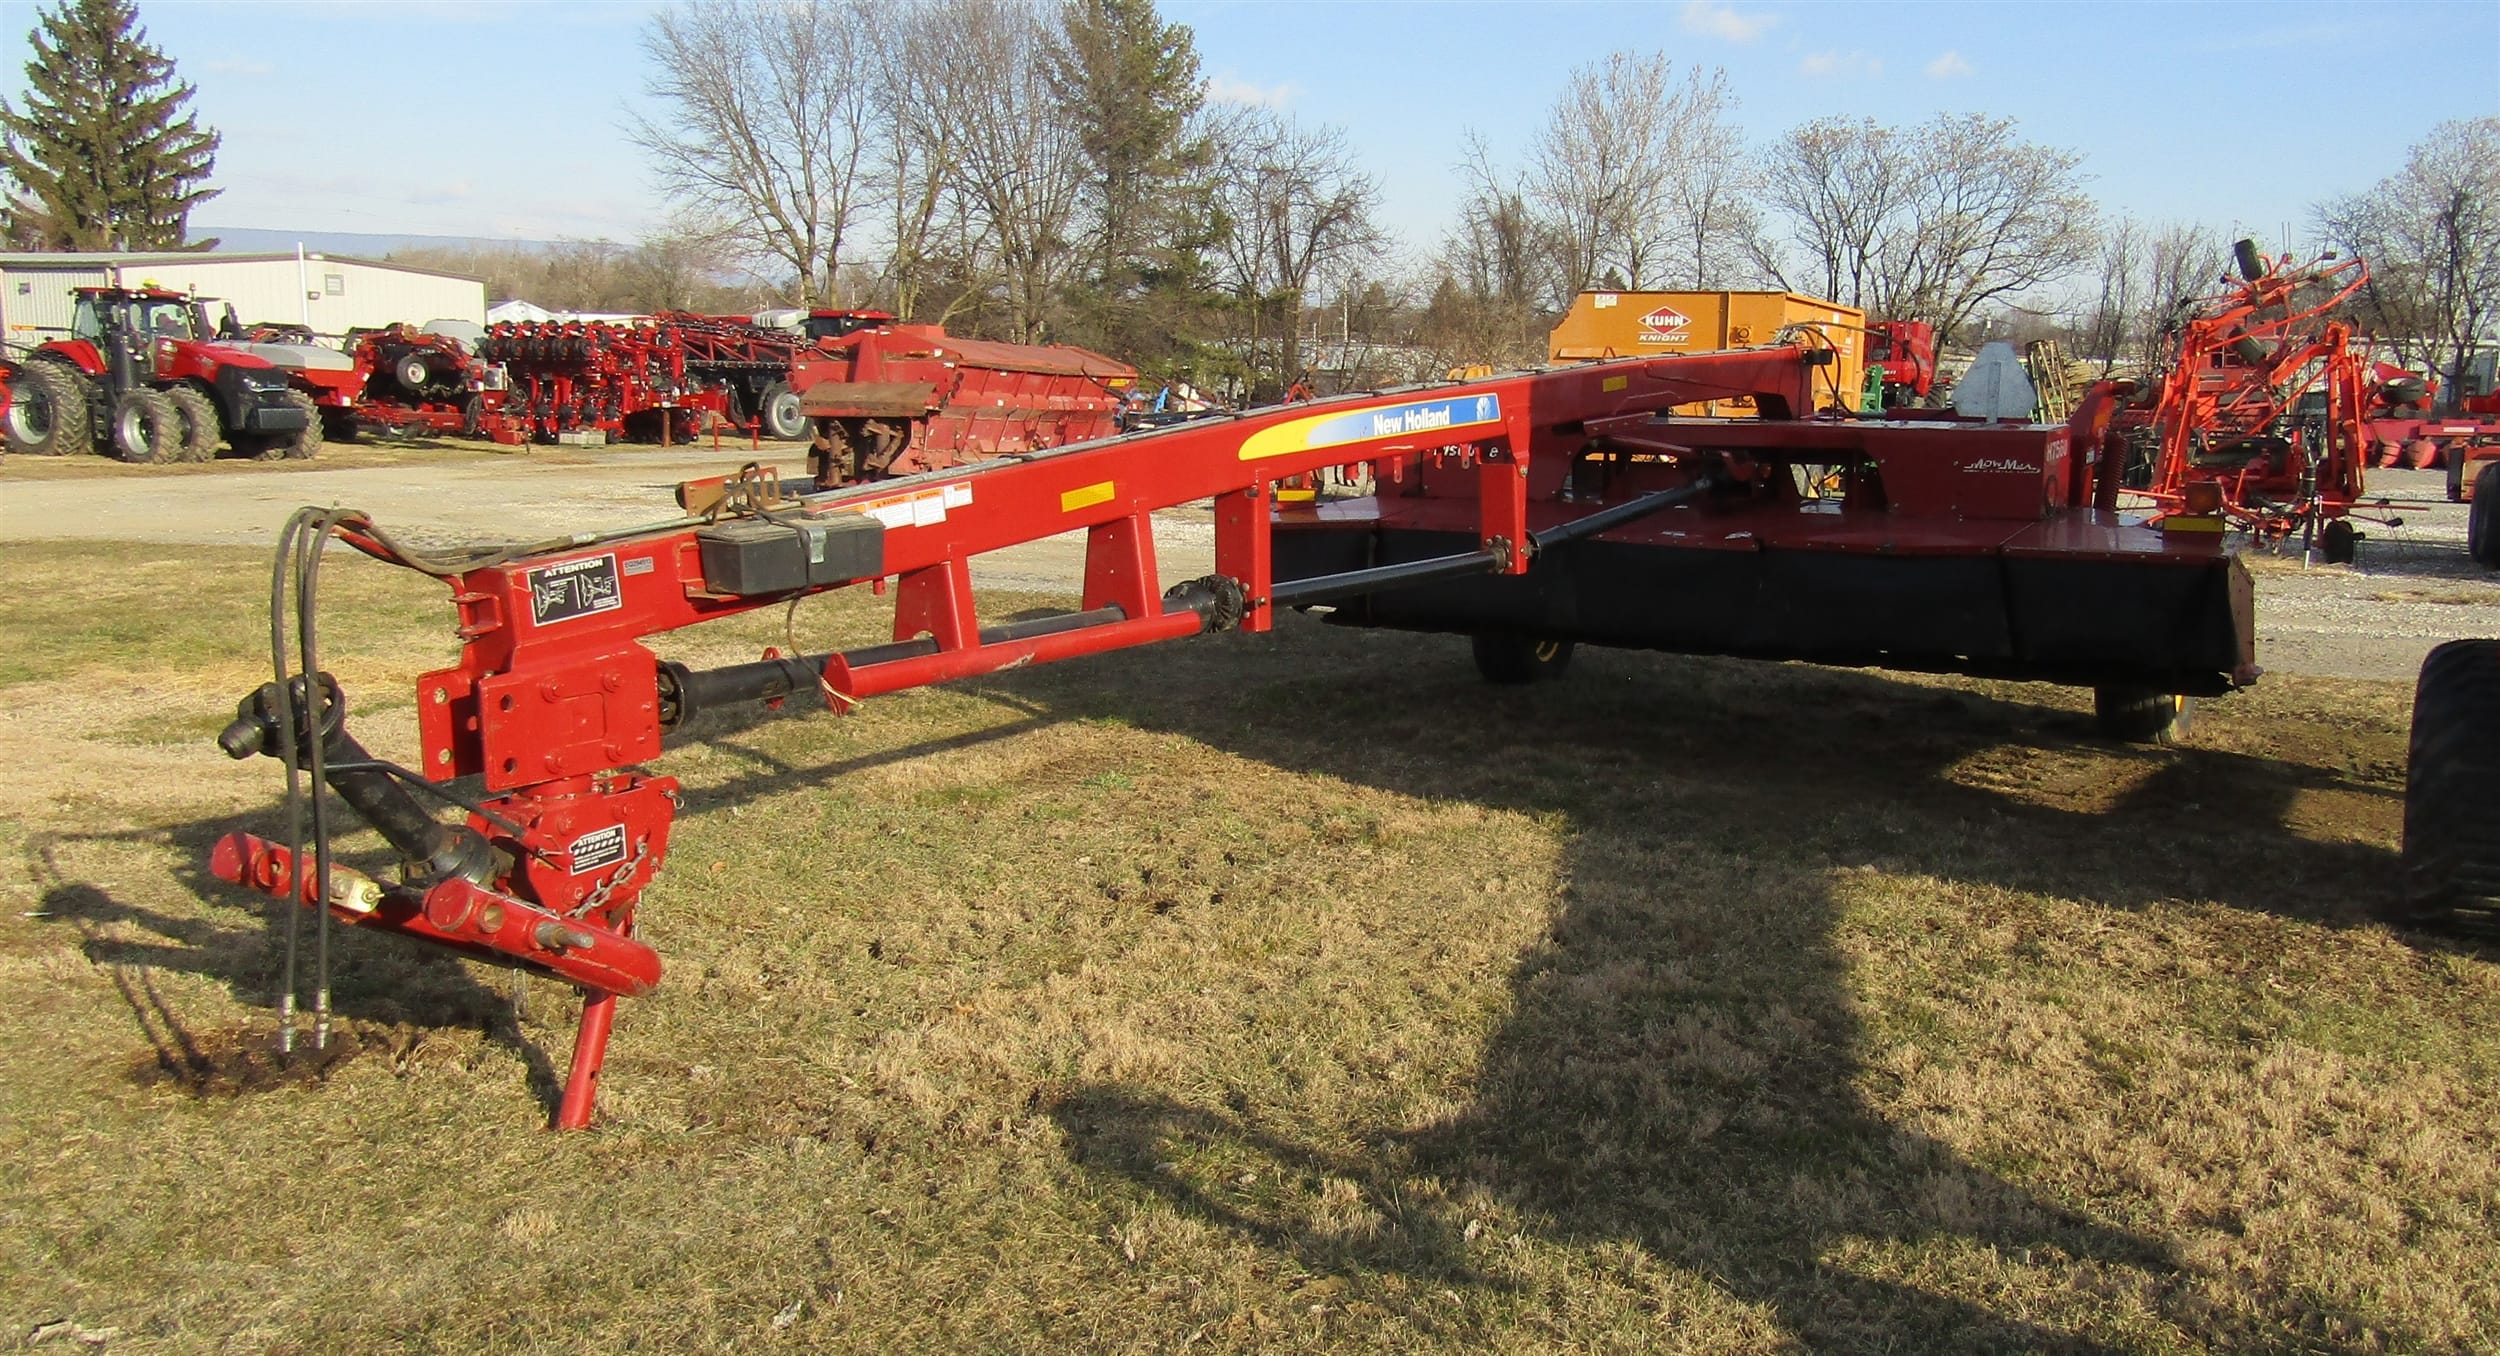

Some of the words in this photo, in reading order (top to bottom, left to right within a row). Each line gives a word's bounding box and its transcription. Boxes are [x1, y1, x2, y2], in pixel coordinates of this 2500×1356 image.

[1645, 315, 1684, 326] KUHN
[1639, 334, 1689, 342] KNIGHT
[1373, 414, 1402, 436] New
[1404, 405, 1450, 431] Holland
[543, 558, 604, 578] ATTENTION
[577, 829, 616, 847] ATTENTION
